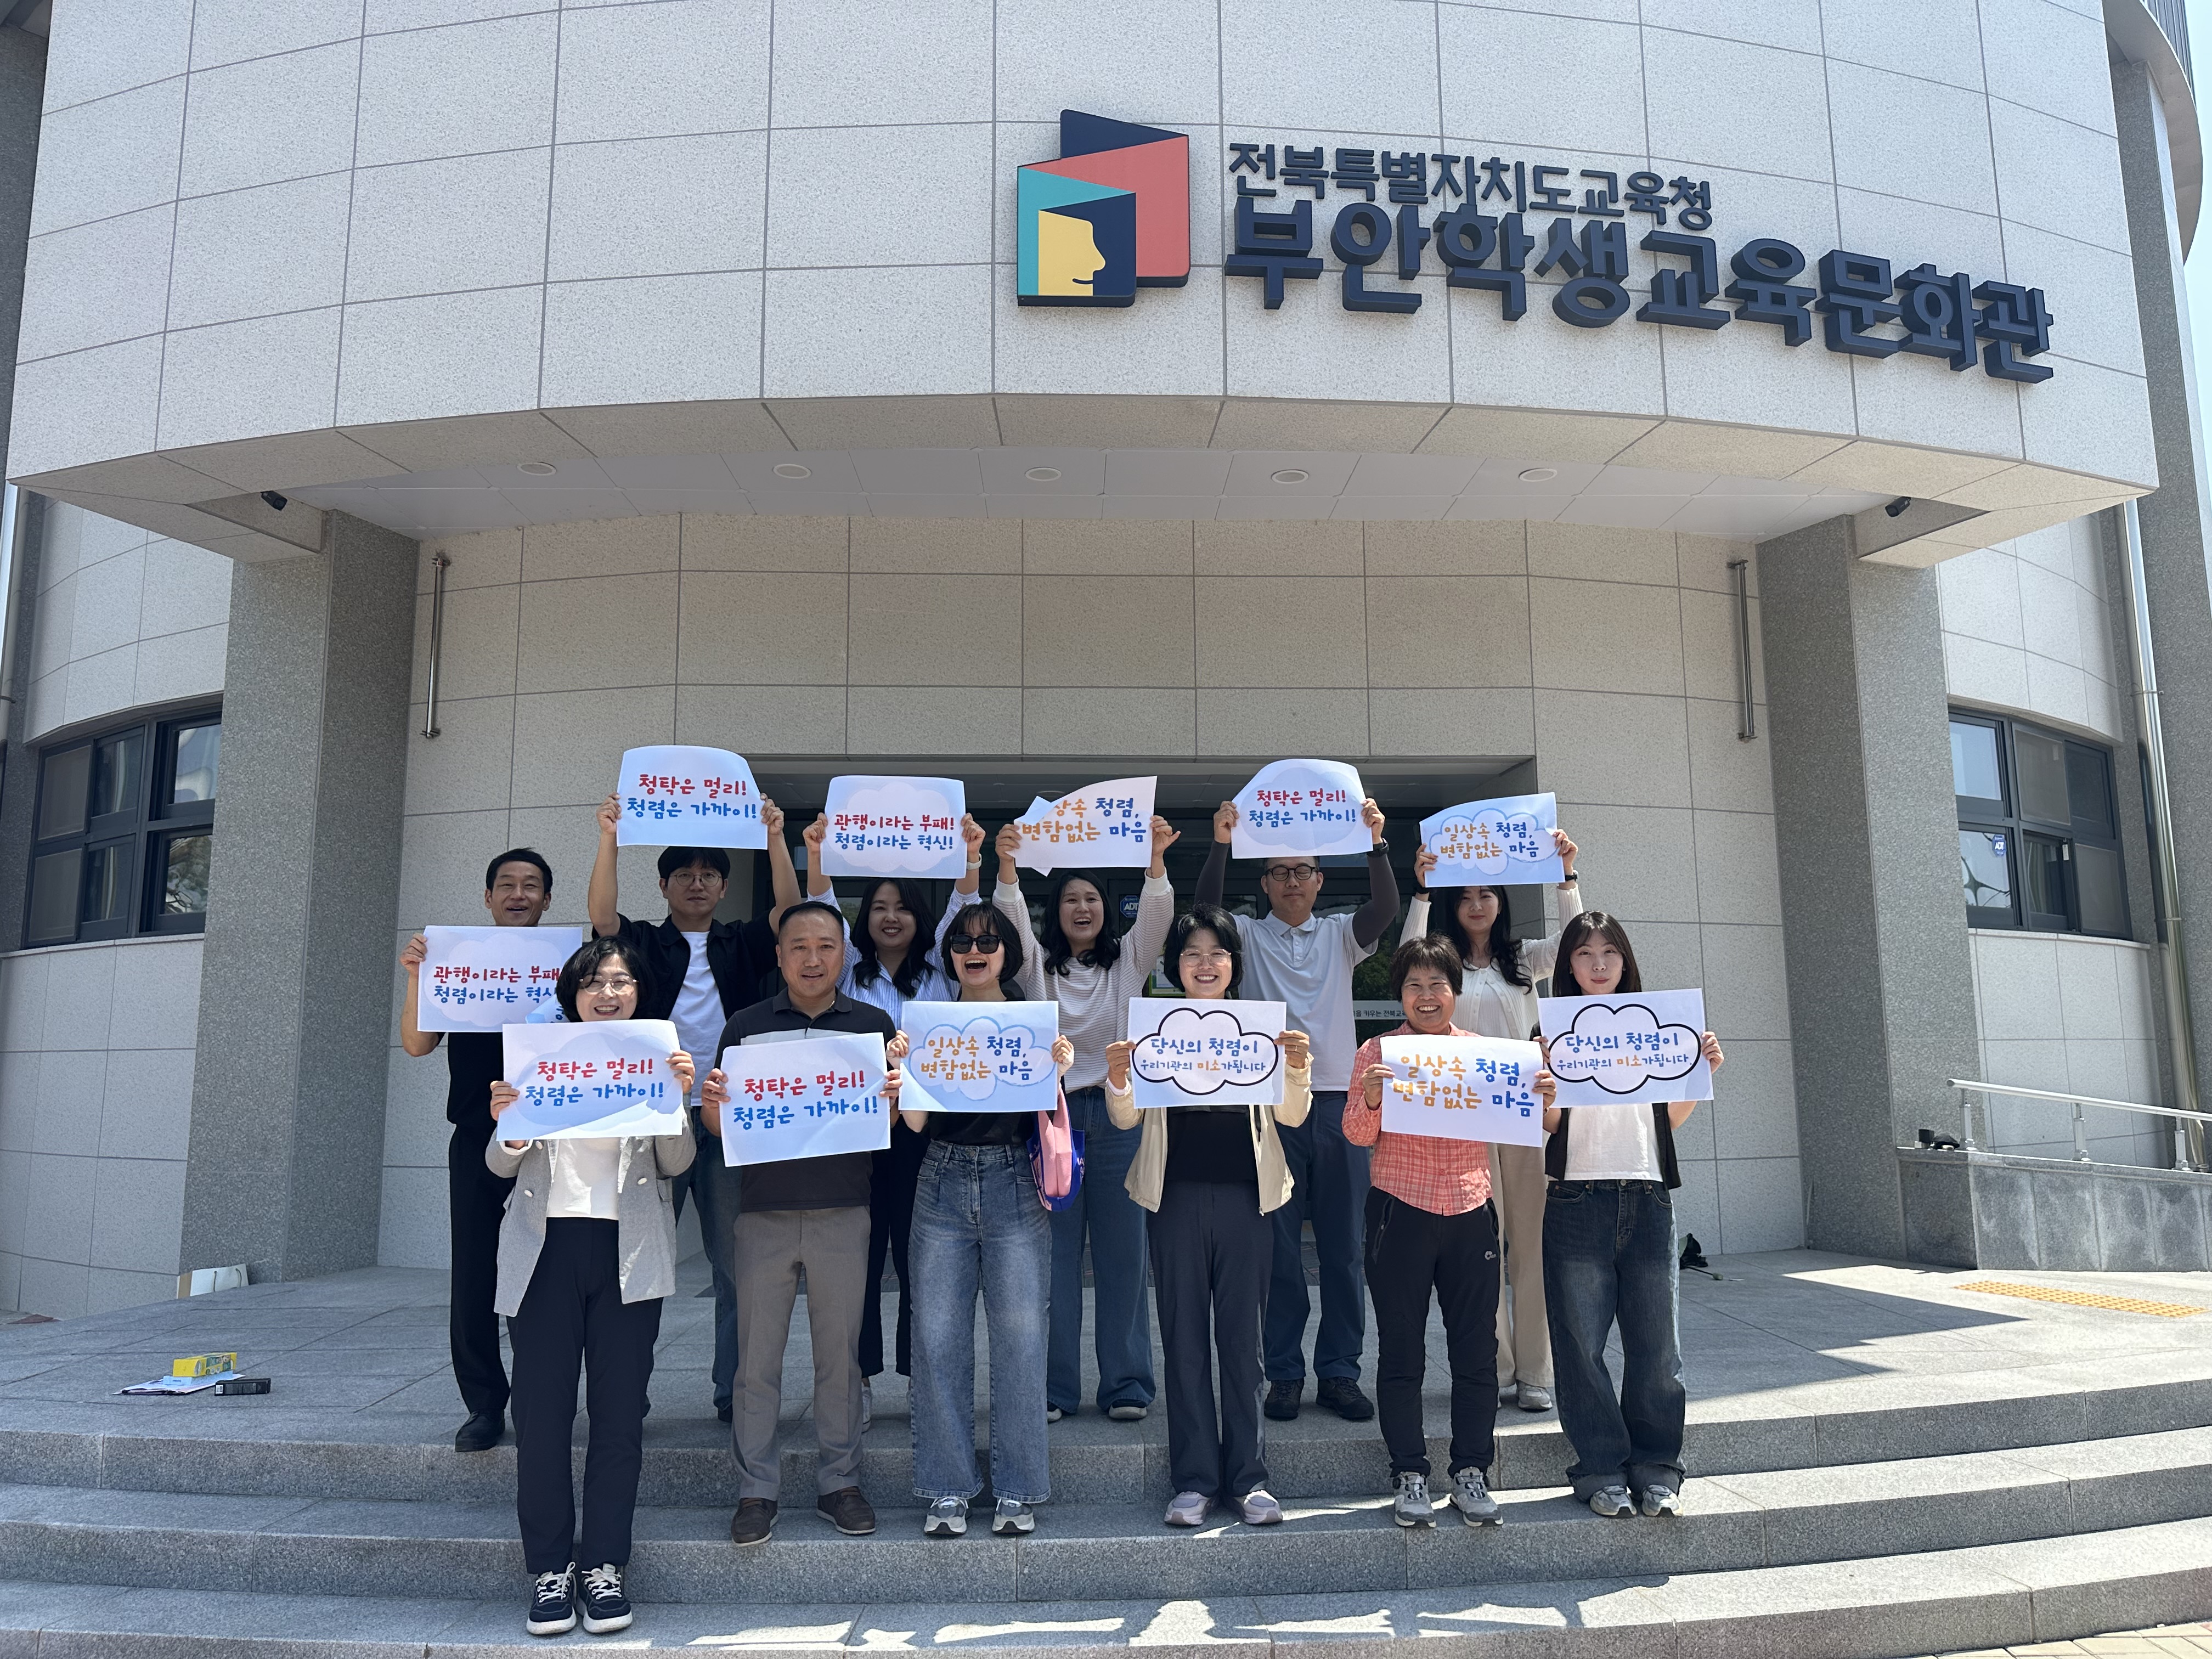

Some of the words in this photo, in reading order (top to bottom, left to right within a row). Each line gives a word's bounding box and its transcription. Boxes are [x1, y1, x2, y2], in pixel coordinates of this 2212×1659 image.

[1228, 142, 1713, 230] 전북특별자치도교육청
[1224, 198, 2053, 383] 부안학생교육문화관
[639, 774, 695, 795] 청탁은
[704, 777, 746, 798] 멀리!
[1257, 791, 1302, 807] 청탁은
[1310, 788, 1345, 806] 멀리!
[628, 798, 682, 819] 청렴은
[691, 802, 758, 819] 가까이!
[1053, 798, 1086, 818] 상속
[1096, 798, 1138, 818] 청렴,
[1249, 810, 1293, 827] 청렴은
[1300, 809, 1356, 822] 가까이!
[834, 814, 913, 831] 관행이라는
[920, 815, 953, 832] 부패!
[1023, 820, 1100, 843] 변함없는
[1109, 821, 1146, 842] 마음
[1445, 823, 1489, 840] 일상속
[1496, 822, 1532, 838] 청렴,
[836, 833, 911, 850] 청렴이라는
[918, 835, 952, 850] 혁신!
[1441, 842, 1502, 859] 변함없는
[1509, 841, 1539, 857] 마음
[1124, 902, 1139, 911] ADT
[434, 967, 521, 983] 관행이라는
[435, 986, 518, 1004] 청렴이라는
[929, 1036, 979, 1058] 일상속
[987, 1036, 1026, 1058] 청렴,
[1151, 1037, 1201, 1054] 당신의
[1209, 1038, 1257, 1056] 청렴이
[1563, 1035, 1618, 1053] 당신의
[1627, 1032, 1678, 1051] 청렴이
[538, 1062, 597, 1081] 청탁은
[607, 1058, 652, 1080] 멀리!
[922, 1060, 991, 1080] 변함없는
[999, 1061, 1032, 1080] 마음
[1141, 1060, 1192, 1071] 우리기관의
[1198, 1060, 1268, 1074] 미소가됩니다.
[1401, 1054, 1466, 1080] 일상속
[1476, 1058, 1525, 1088] 청렴,
[1558, 1059, 1611, 1070] 우리기관의
[1617, 1054, 1693, 1068] 미소가됩니다.
[526, 1085, 583, 1106] 청렴은
[593, 1082, 663, 1098] 가까이!
[745, 1077, 806, 1101] 청탁은
[816, 1070, 864, 1096] 멀리!
[1393, 1079, 1481, 1109] 변함없는
[1492, 1090, 1535, 1116] 마음
[734, 1105, 794, 1130] 청렴은
[804, 1094, 877, 1117] 가까이!
